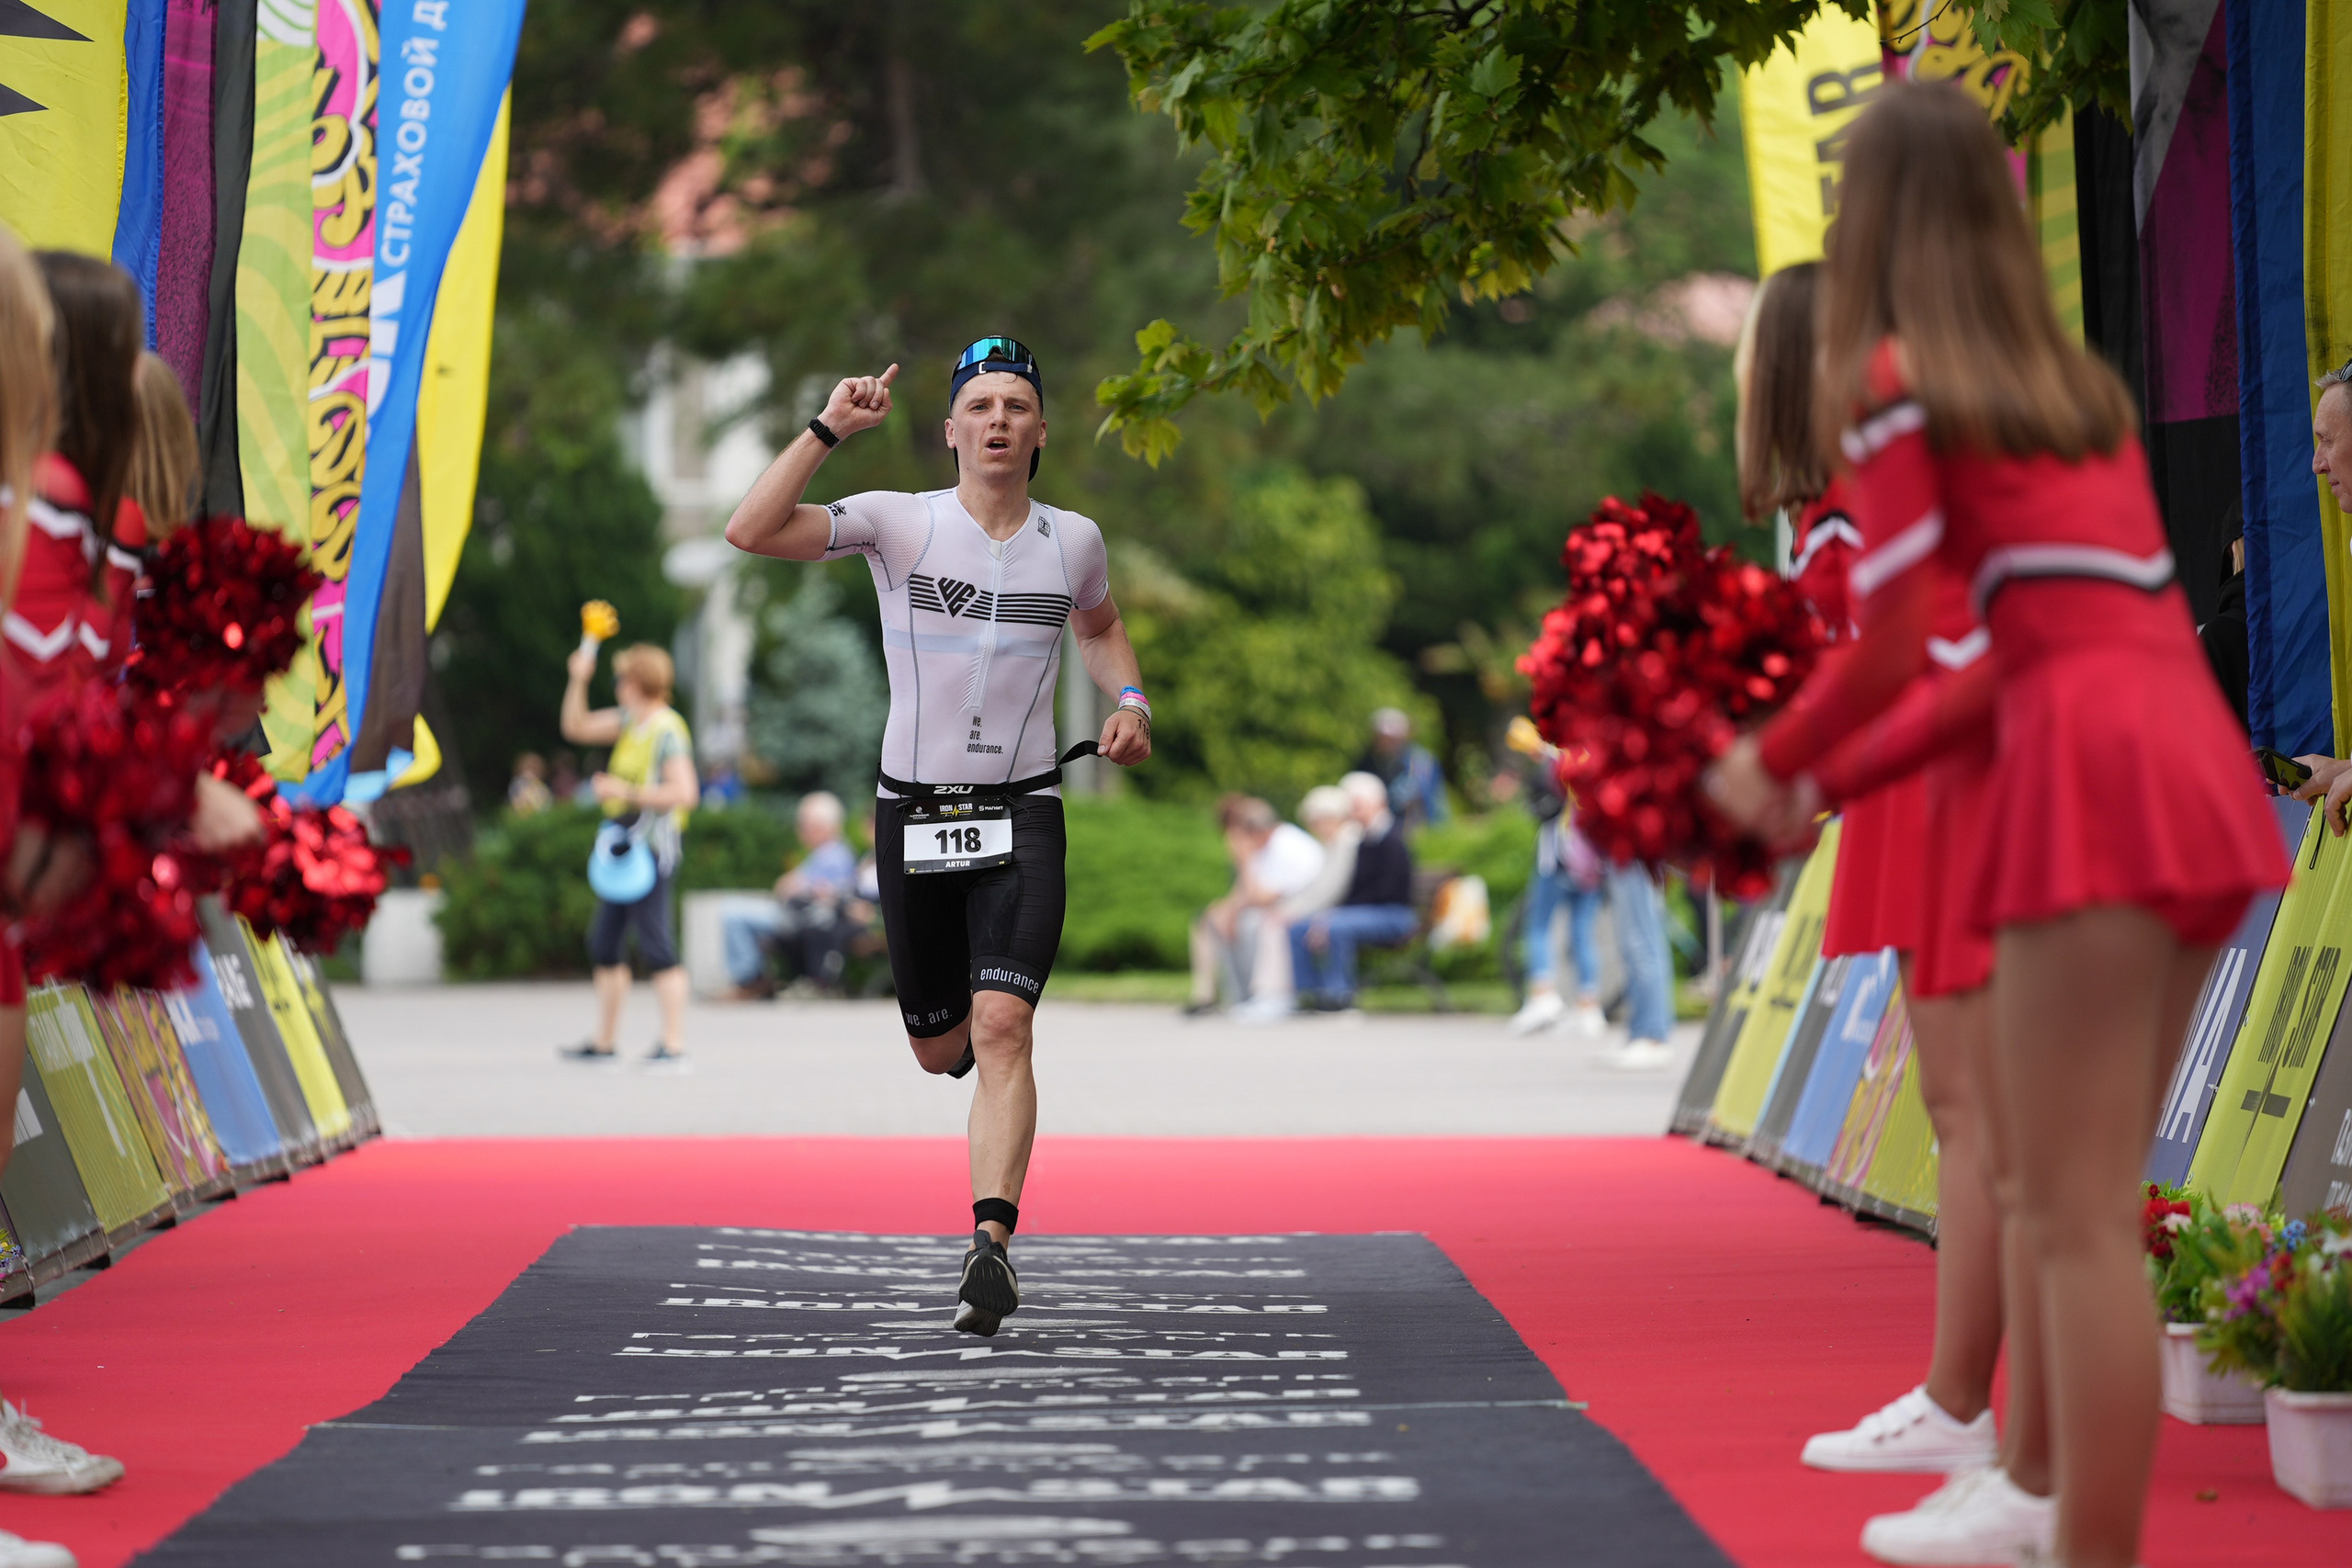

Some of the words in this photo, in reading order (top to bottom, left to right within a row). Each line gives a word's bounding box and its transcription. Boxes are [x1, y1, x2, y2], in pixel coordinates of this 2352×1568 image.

[379, 37, 439, 268] СТРАХОВОЙ
[969, 729, 981, 740] are.
[967, 742, 1004, 754] endurance.
[933, 785, 974, 795] 2XU
[939, 804, 954, 812] IRON
[957, 802, 973, 811] STAR
[934, 827, 982, 854] 118
[944, 860, 971, 868] ARTUR
[979, 966, 1040, 997] endurance.
[2281, 945, 2342, 1069] STAR
[905, 1012, 925, 1026] we.
[928, 1009, 953, 1024] are.
[666, 1297, 920, 1309] IRON
[1057, 1302, 1329, 1313] STAR
[1052, 1347, 1348, 1358] STAR
